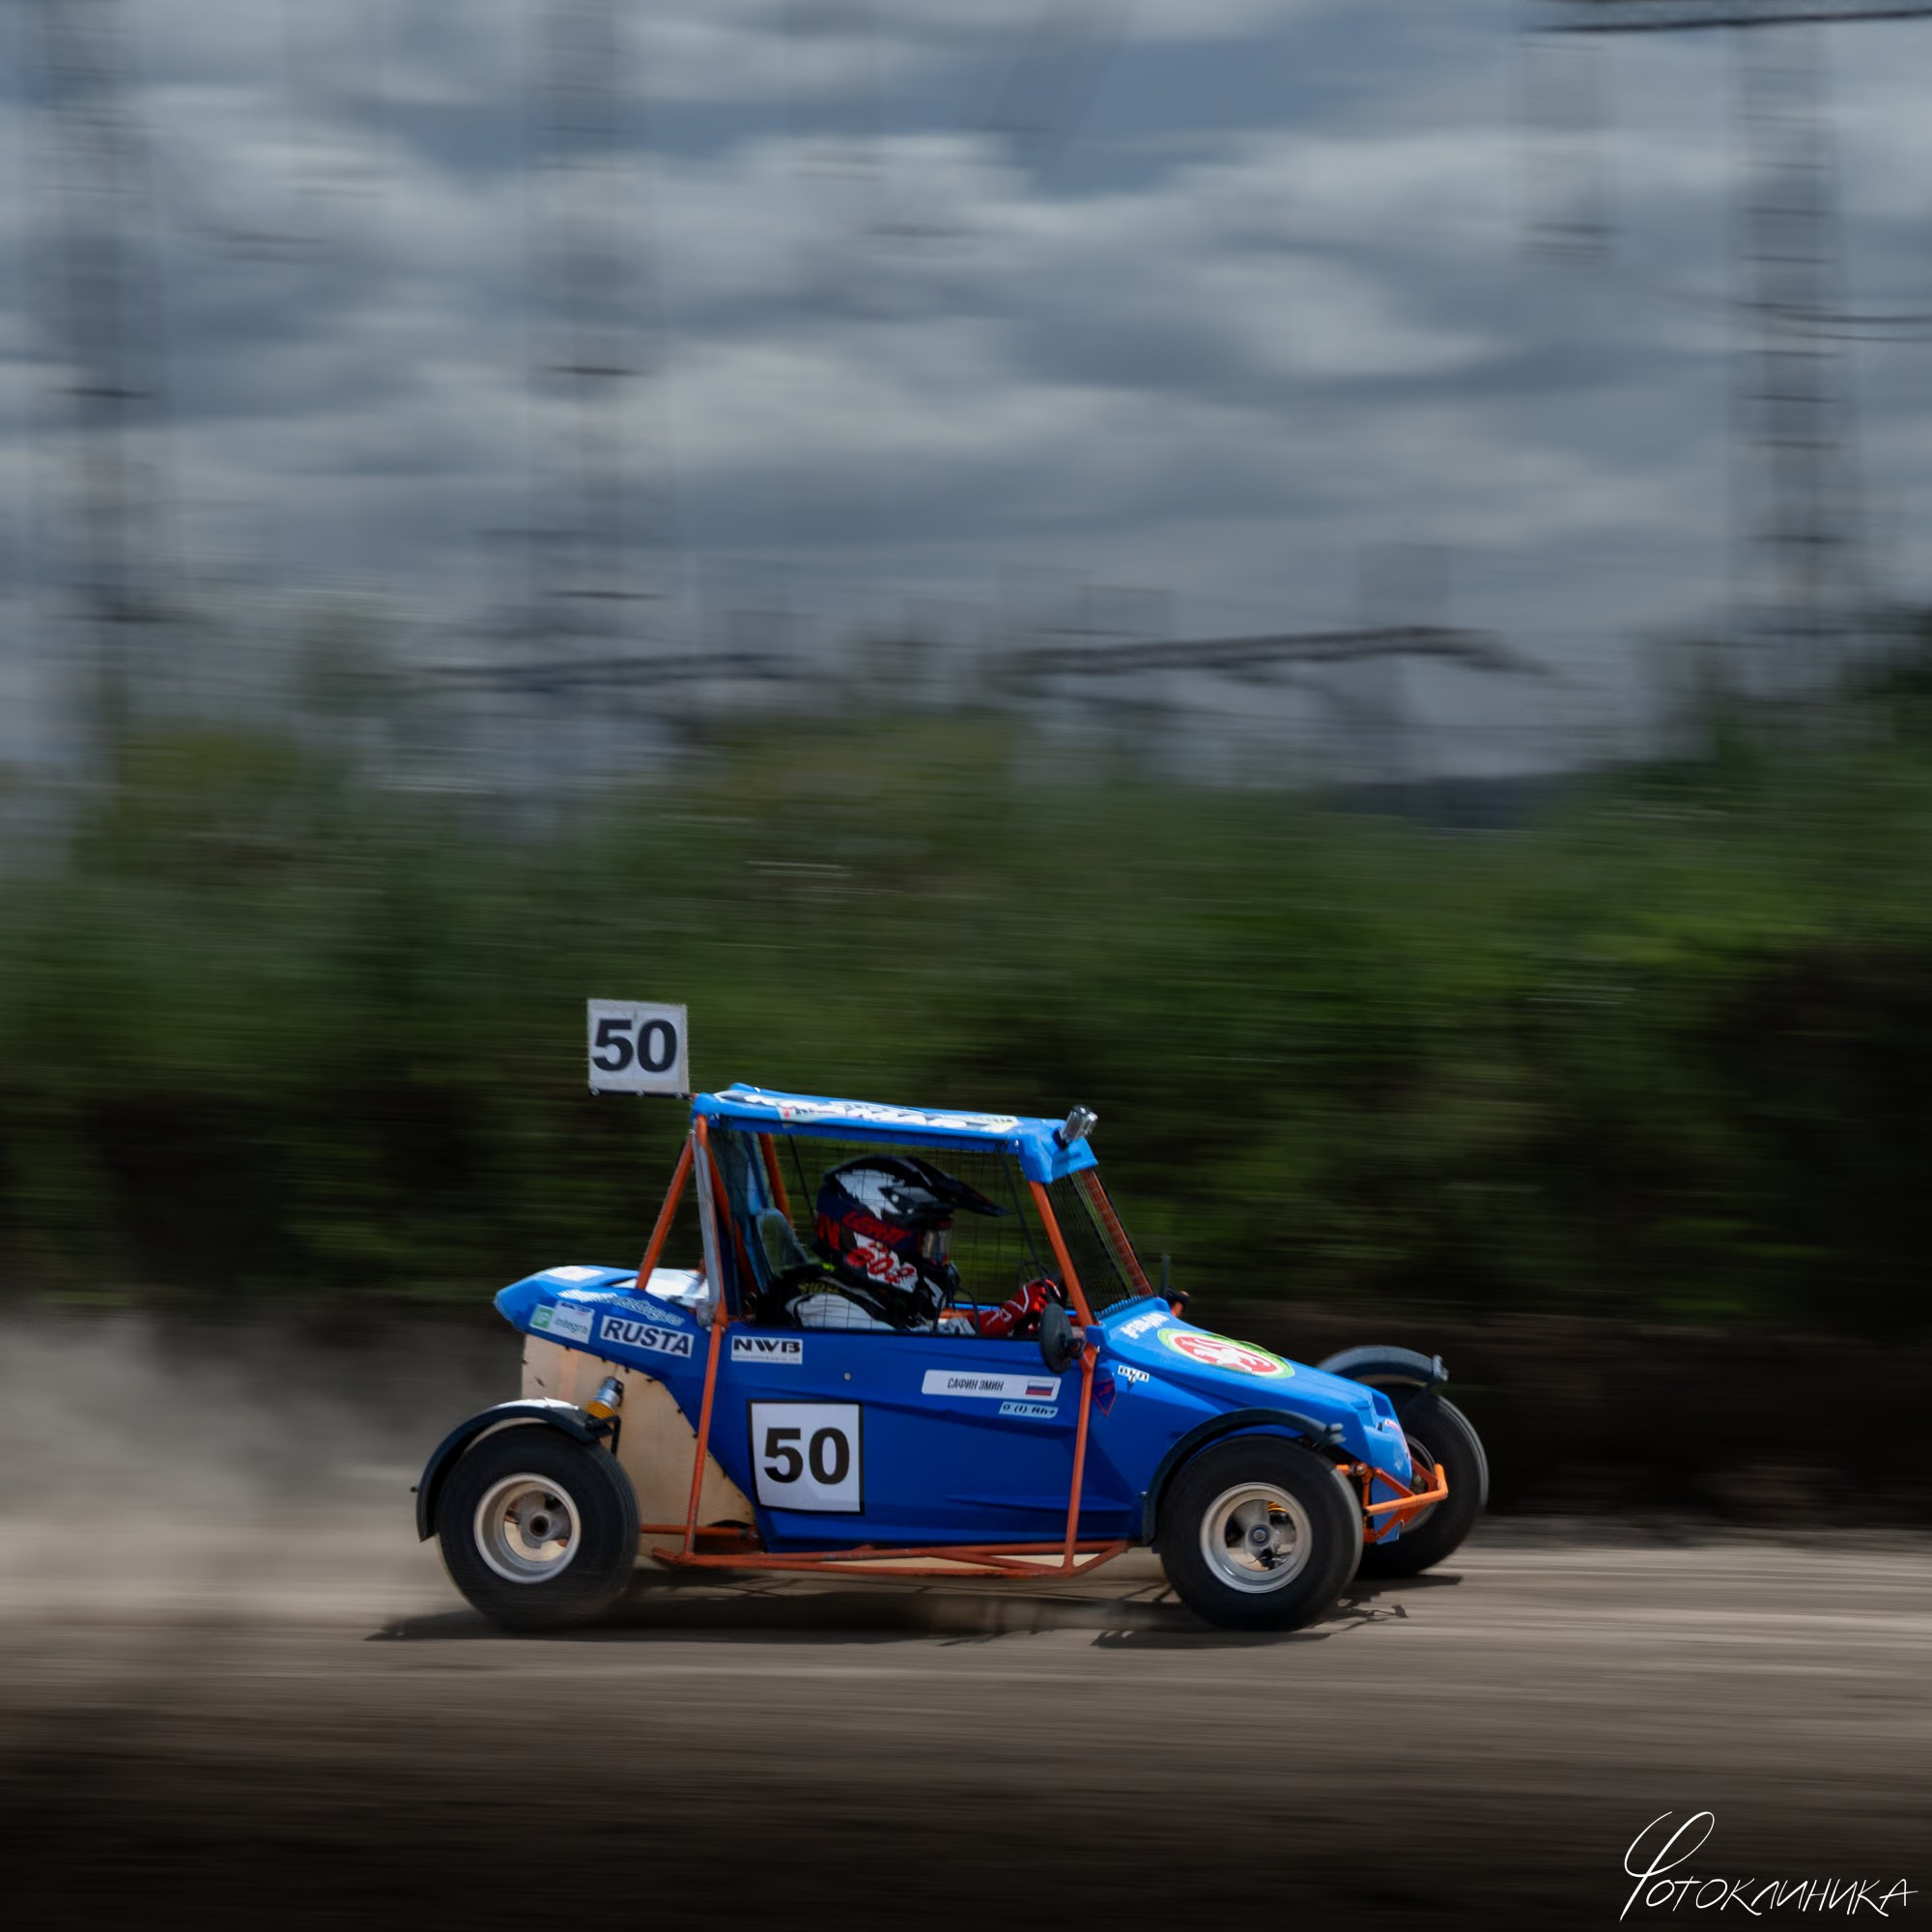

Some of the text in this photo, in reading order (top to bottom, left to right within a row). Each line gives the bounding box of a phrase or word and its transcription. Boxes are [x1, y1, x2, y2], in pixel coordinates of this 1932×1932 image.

[592, 1018, 677, 1073] 50
[603, 1319, 689, 1355] RUSTA
[733, 1338, 801, 1353] NWB
[947, 1377, 1005, 1392] САФИН ЭМИН
[763, 1427, 850, 1485] 50
